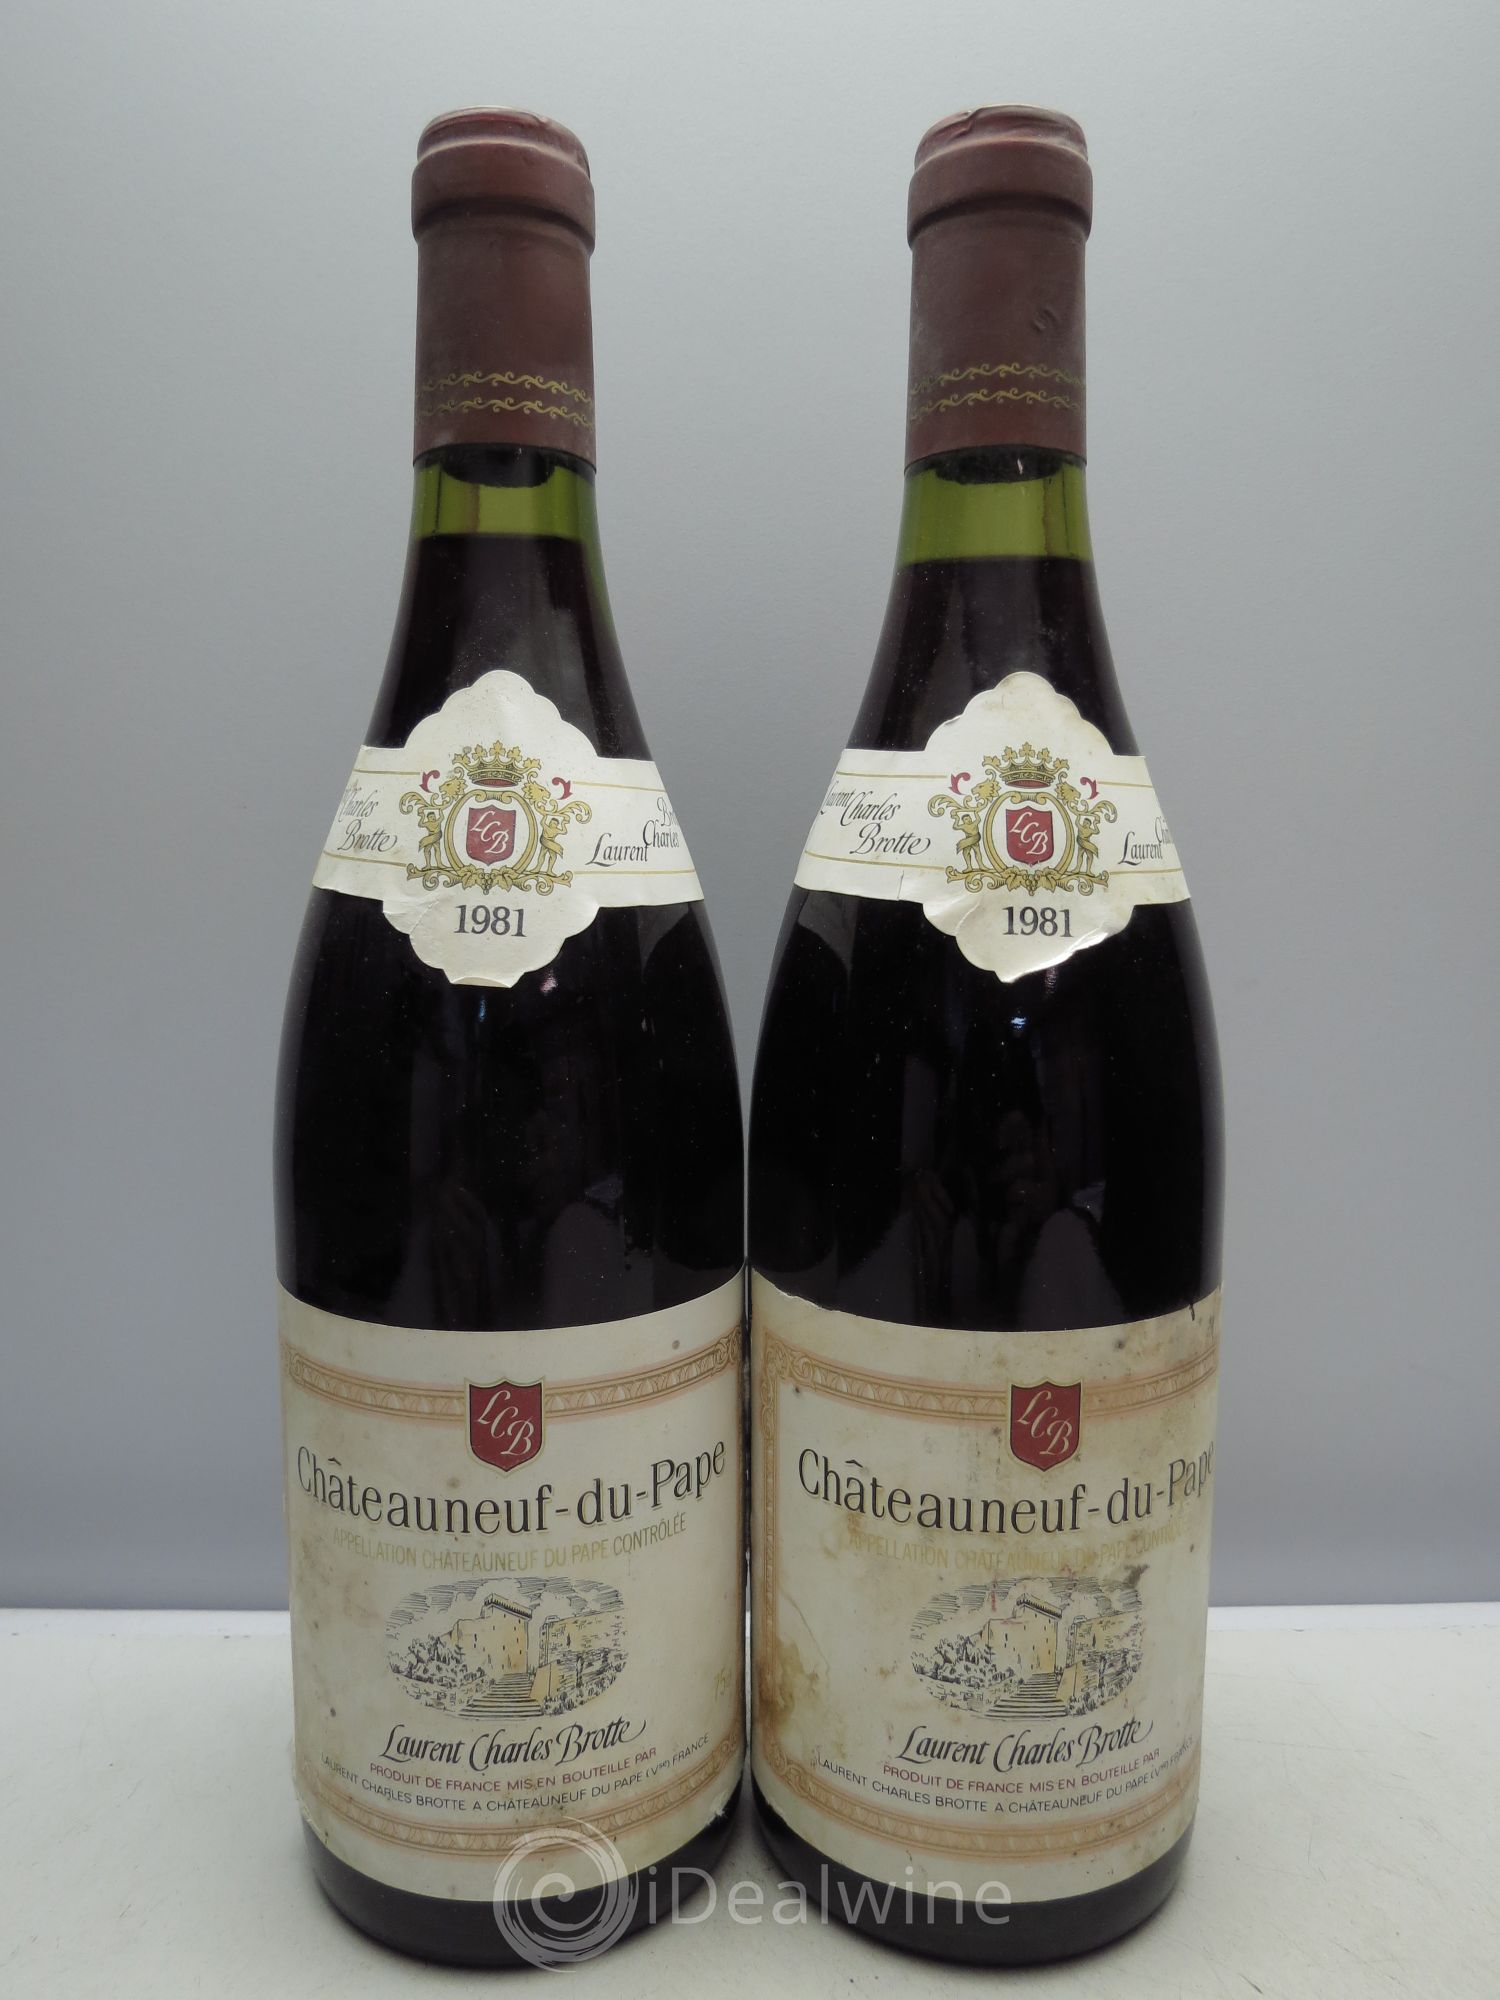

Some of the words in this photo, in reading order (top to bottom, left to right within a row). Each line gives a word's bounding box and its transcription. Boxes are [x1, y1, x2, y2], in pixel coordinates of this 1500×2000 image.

[840, 790, 901, 826] Charles
[337, 818, 397, 852] Brotte
[472, 810, 508, 854] LCB
[585, 832, 649, 867] Laurent
[849, 821, 931, 855] Brotte
[1009, 812, 1050, 855] LCB
[1117, 831, 1163, 866] Laurent
[454, 904, 527, 937] 1981
[1002, 905, 1073, 937] 1981
[477, 1389, 535, 1455] LCB
[1017, 1390, 1073, 1456] LCB
[298, 1440, 726, 1535] Châteauneuf-du-Pape
[333, 1528, 416, 1567] APPELLATION
[544, 1547, 567, 1568] DU
[572, 1539, 609, 1564] PAPE
[613, 1511, 687, 1556] CONTRÔLÉE
[380, 1723, 464, 1764] Laurent
[469, 1726, 551, 1772] Charles
[554, 1718, 647, 1767] Brotte
[896, 1725, 989, 1765] Laurent
[993, 1727, 1076, 1773] Charles
[1075, 1717, 1154, 1768] Brotte
[321, 1752, 358, 1785] LAURENT
[361, 1778, 412, 1805] CHARLES
[416, 1794, 467, 1811] BROTTE
[591, 1782, 611, 1798] DU
[614, 1772, 643, 1792] PAPE
[672, 1732, 709, 1766] FRANCE
[370, 1762, 422, 1786] PRODUIT
[425, 1776, 442, 1789] DE
[446, 1779, 501, 1792] FRANCE
[507, 1779, 532, 1791] MIS
[536, 1775, 556, 1788] EN
[562, 1757, 630, 1785] BOUTEILLE
[634, 1747, 656, 1764] PAR
[817, 1750, 868, 1786] LAURENT
[872, 1780, 931, 1805] CHARLES
[935, 1796, 988, 1812] BROTTE
[1106, 1785, 1123, 1799] DU
[1125, 1772, 1149, 1793] PAPE
[883, 1764, 942, 1787] PRODUIT
[946, 1778, 964, 1790] DE
[968, 1780, 1023, 1793] FRANCE
[1029, 1781, 1054, 1792] MIS
[1058, 1778, 1076, 1790] EN
[1081, 1759, 1139, 1786] BOUTEILLE
[1142, 1748, 1160, 1765] PAR
